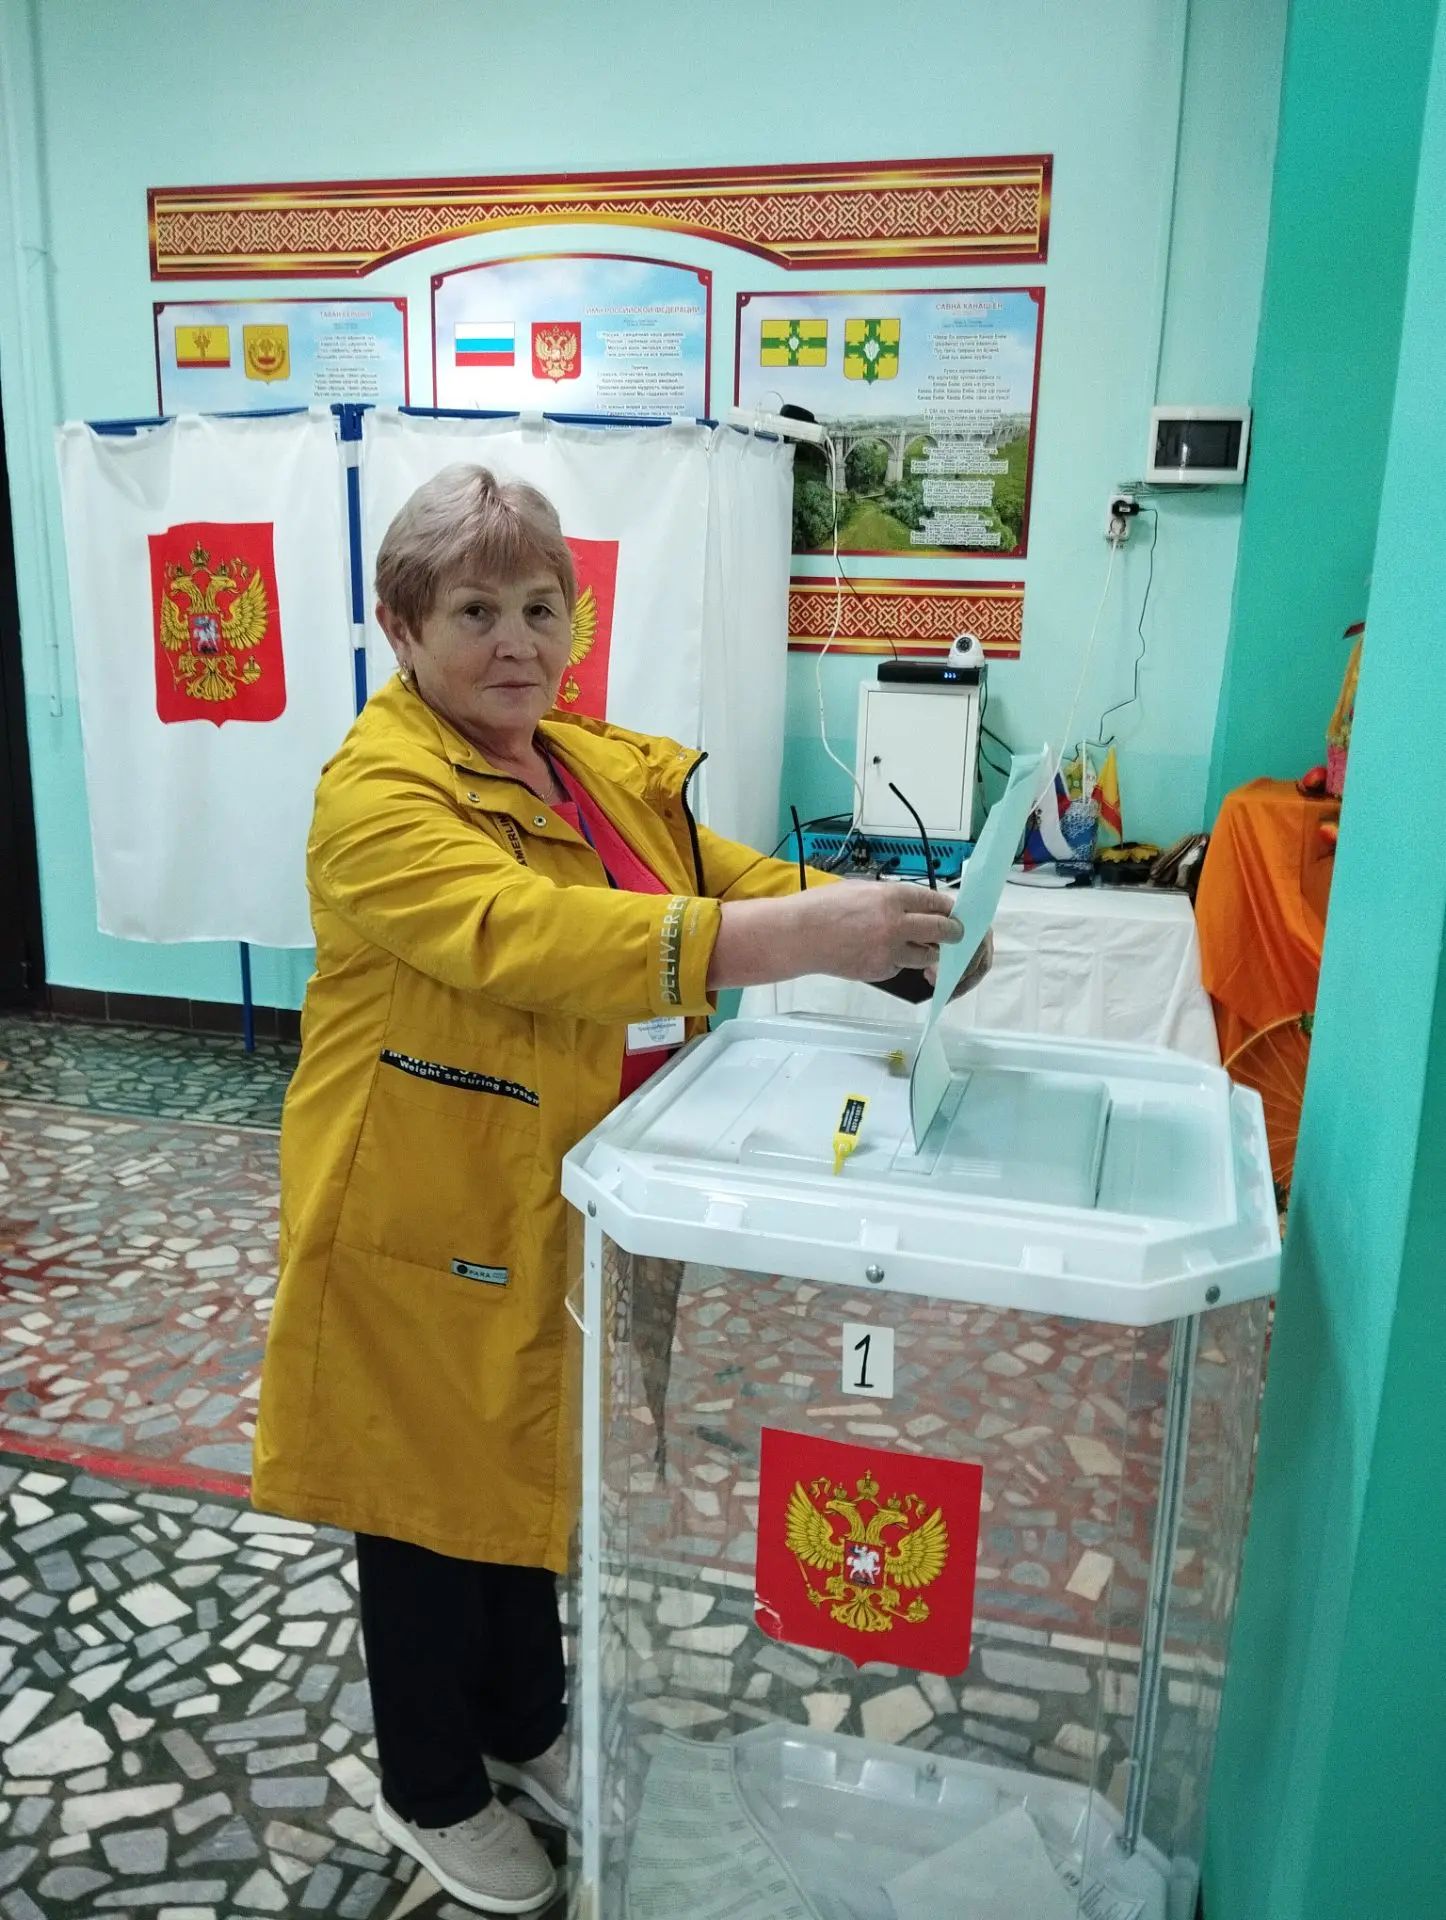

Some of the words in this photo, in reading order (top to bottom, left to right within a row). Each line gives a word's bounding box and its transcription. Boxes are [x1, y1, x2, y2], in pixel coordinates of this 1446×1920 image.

[399, 1060, 441, 1078] Weight
[444, 1073, 500, 1091] securing
[854, 1334, 874, 1389] 1
